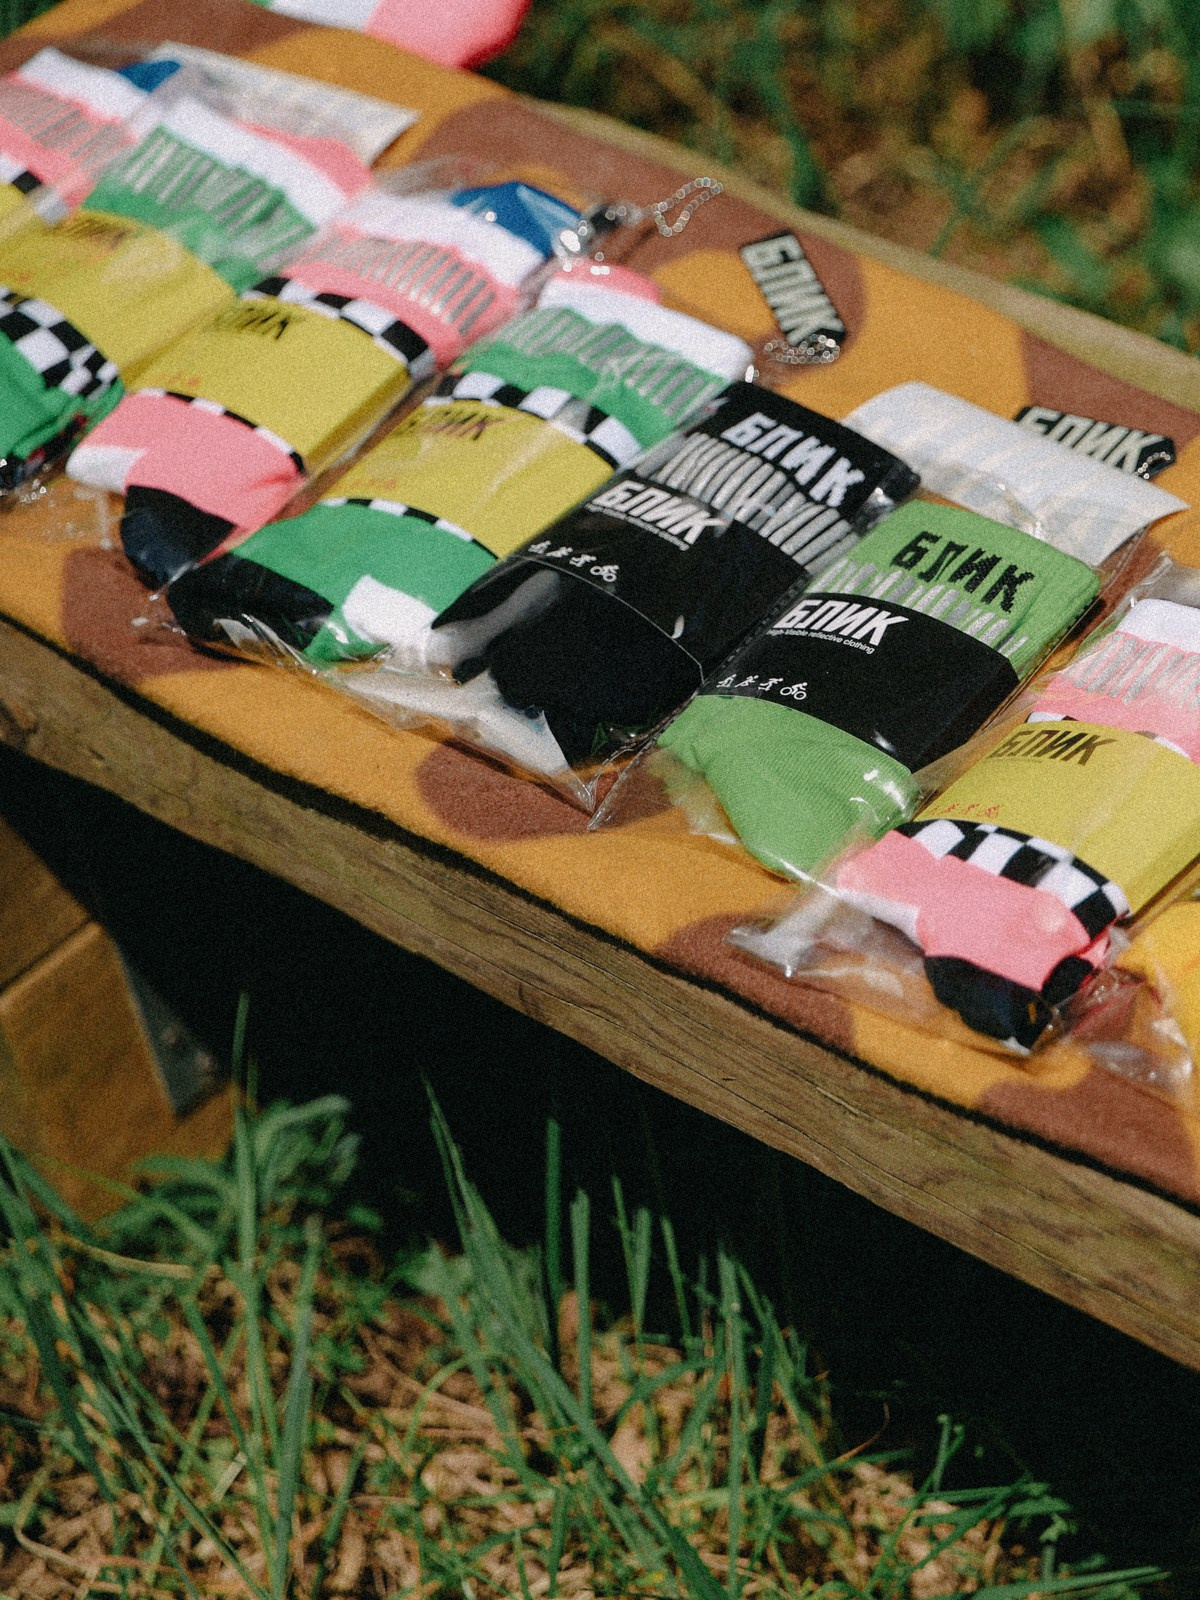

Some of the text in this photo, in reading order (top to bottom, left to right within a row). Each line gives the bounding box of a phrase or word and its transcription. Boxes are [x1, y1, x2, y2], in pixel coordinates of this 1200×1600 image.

[740, 234, 845, 346] БЛИК
[721, 411, 866, 508] БЛИК
[592, 480, 727, 545] БЛИК
[890, 530, 1035, 613] БЛИК
[772, 599, 909, 646] БЛИК
[843, 639, 876, 655] clothing
[984, 729, 1118, 767] БЛИК
